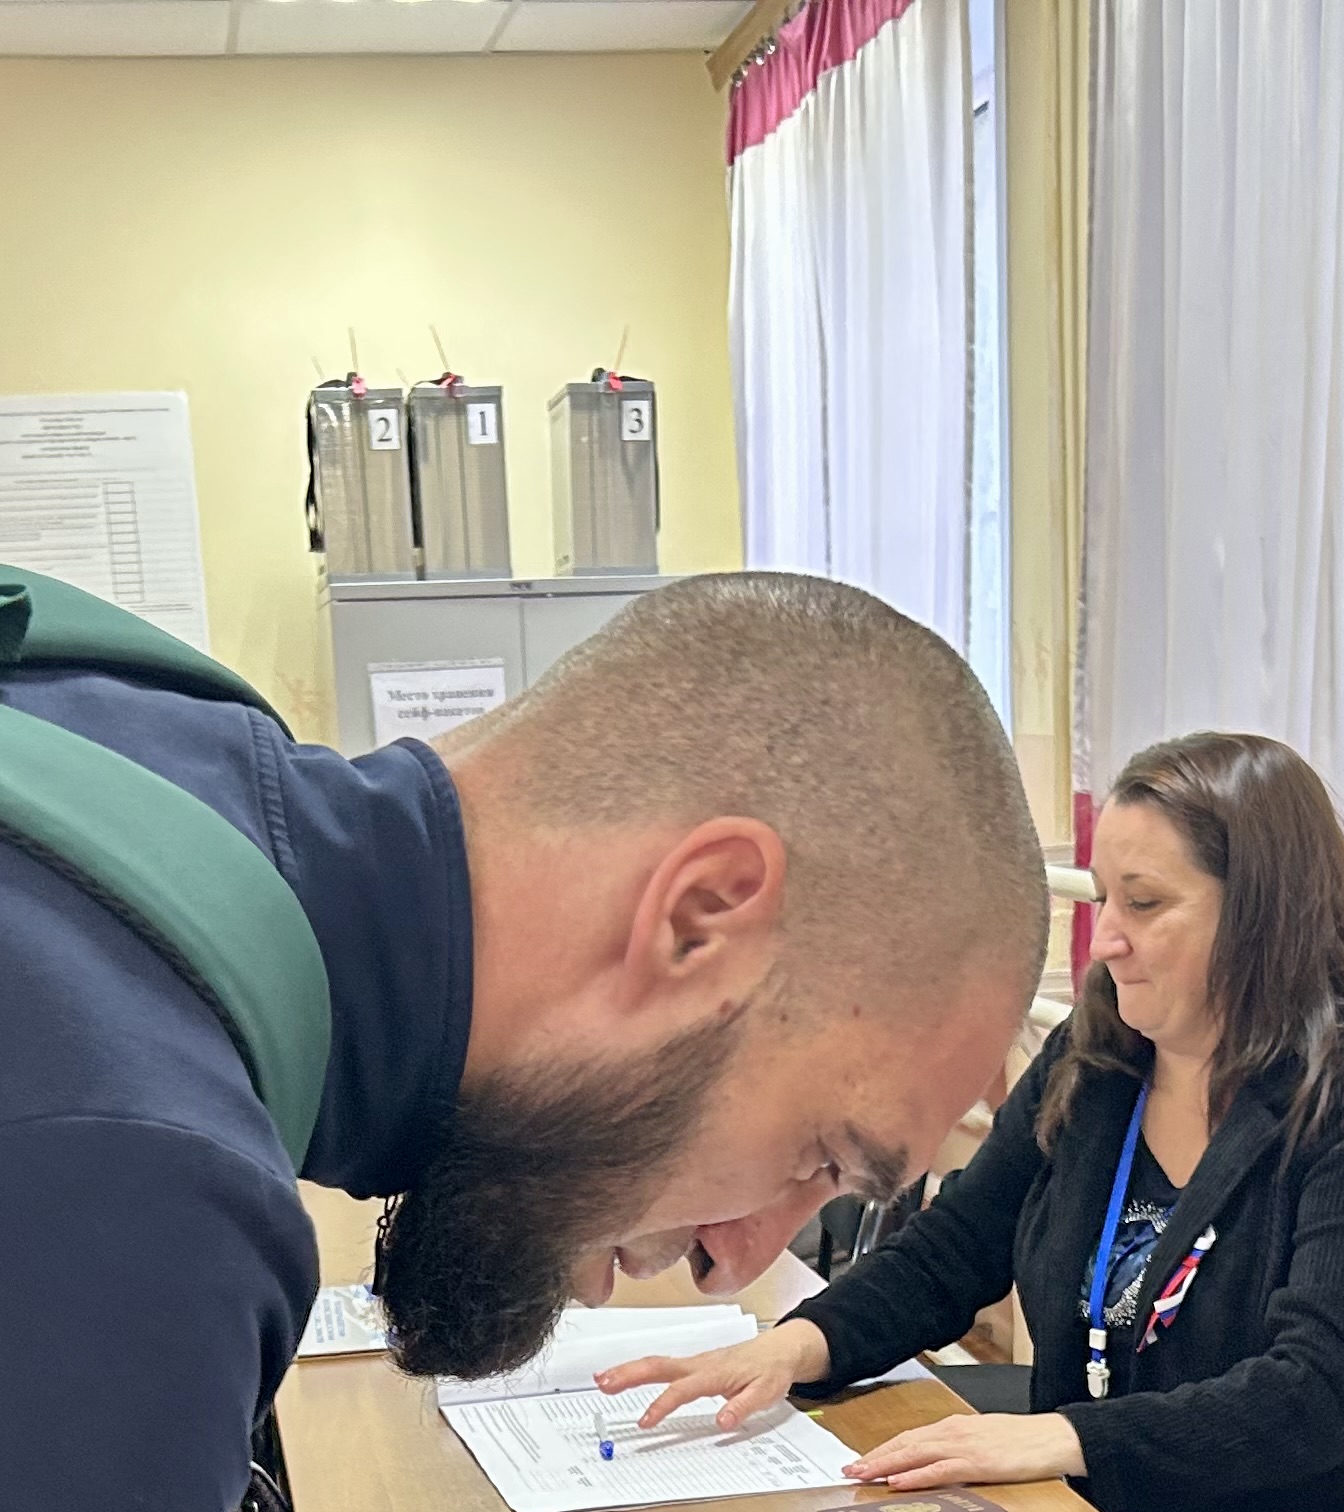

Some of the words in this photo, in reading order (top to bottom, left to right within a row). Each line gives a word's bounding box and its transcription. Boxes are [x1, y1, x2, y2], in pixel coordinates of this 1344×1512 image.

[377, 416, 393, 443] 2
[477, 410, 488, 437] 1
[627, 407, 644, 434] 3
